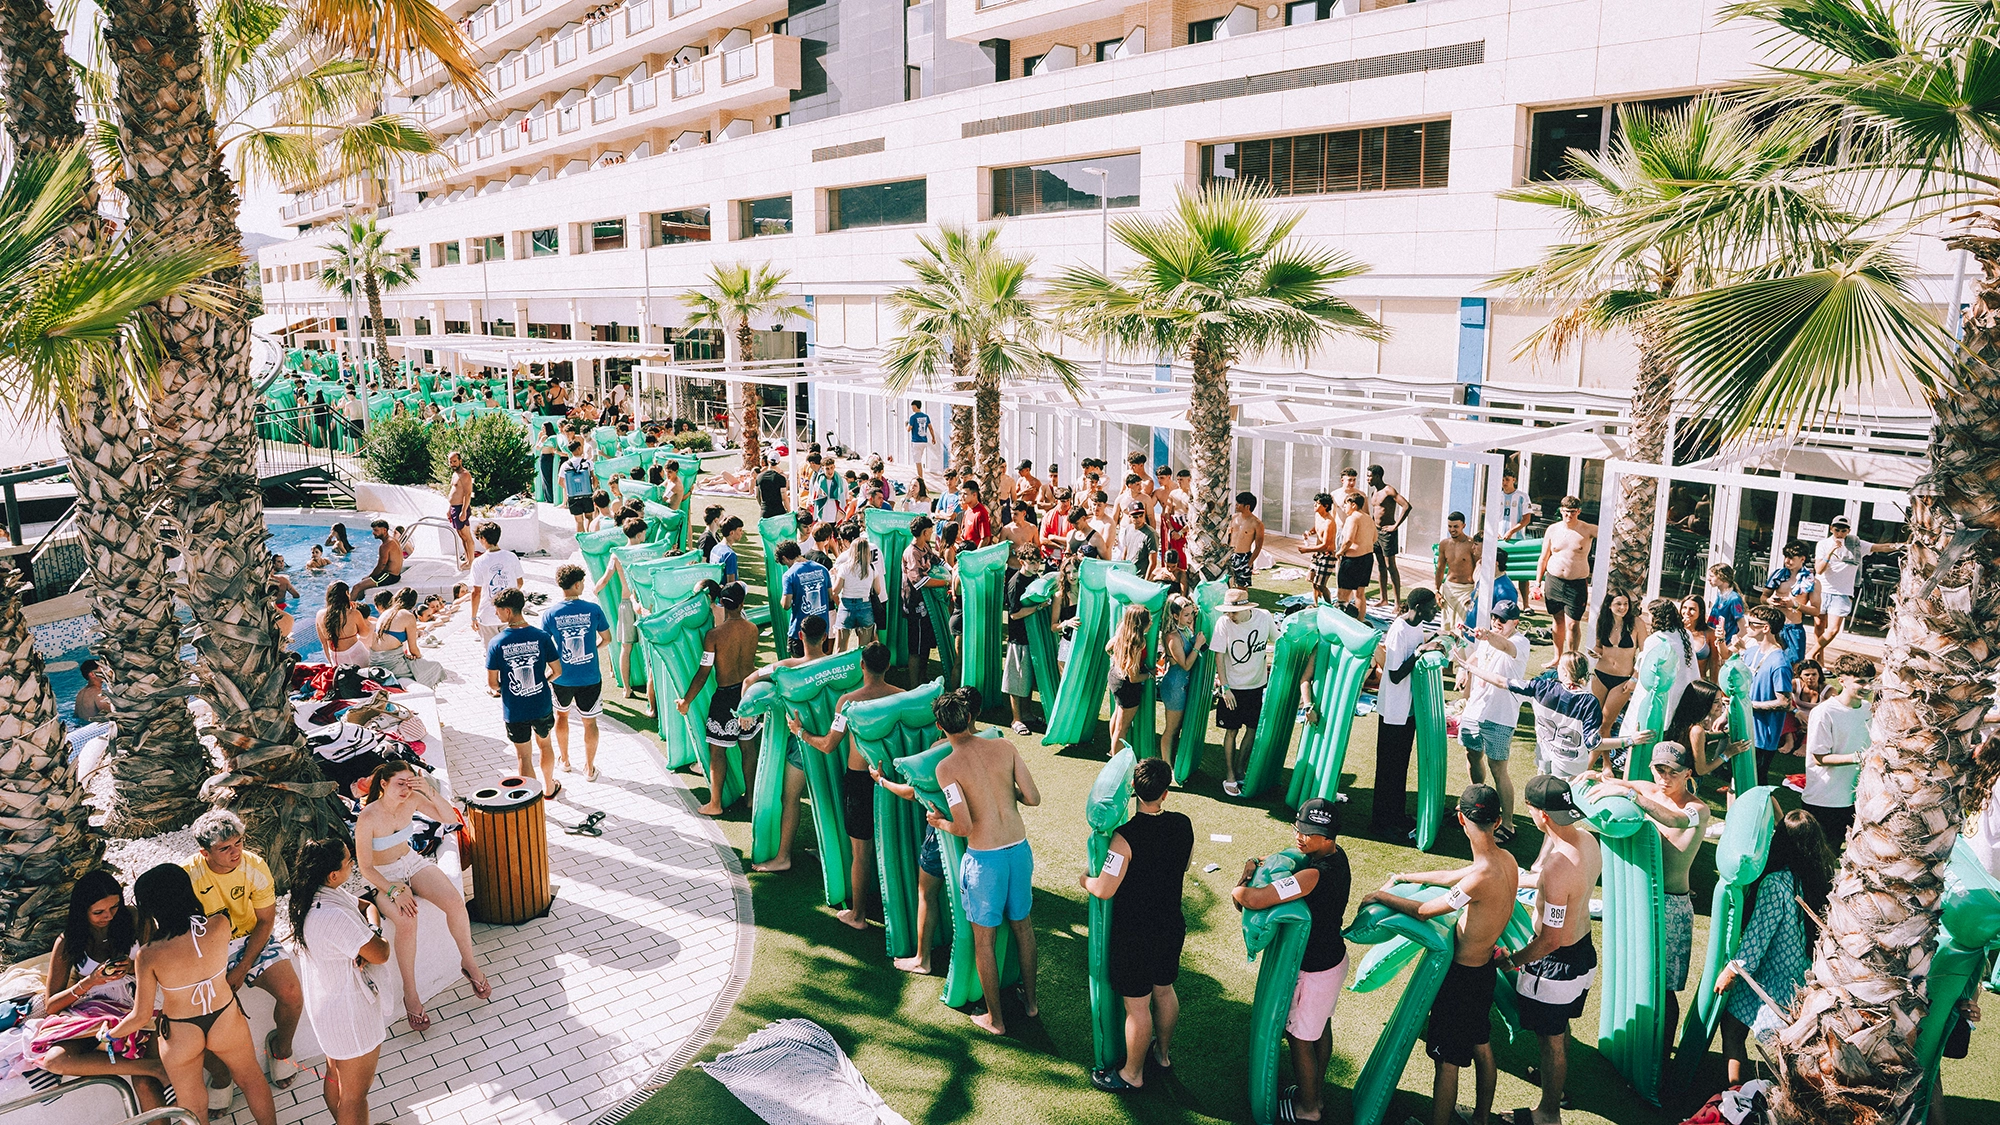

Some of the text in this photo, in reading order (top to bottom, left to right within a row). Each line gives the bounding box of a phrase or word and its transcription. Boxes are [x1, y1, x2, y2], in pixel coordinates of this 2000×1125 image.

[665, 614, 674, 624] LA
[672, 608, 685, 620] CASA
[692, 601, 702, 609] LAS
[804, 663, 856, 685] LA CASA DE LAS
[815, 672, 848, 687] CARCASAS
[1550, 907, 1565, 920] 860
